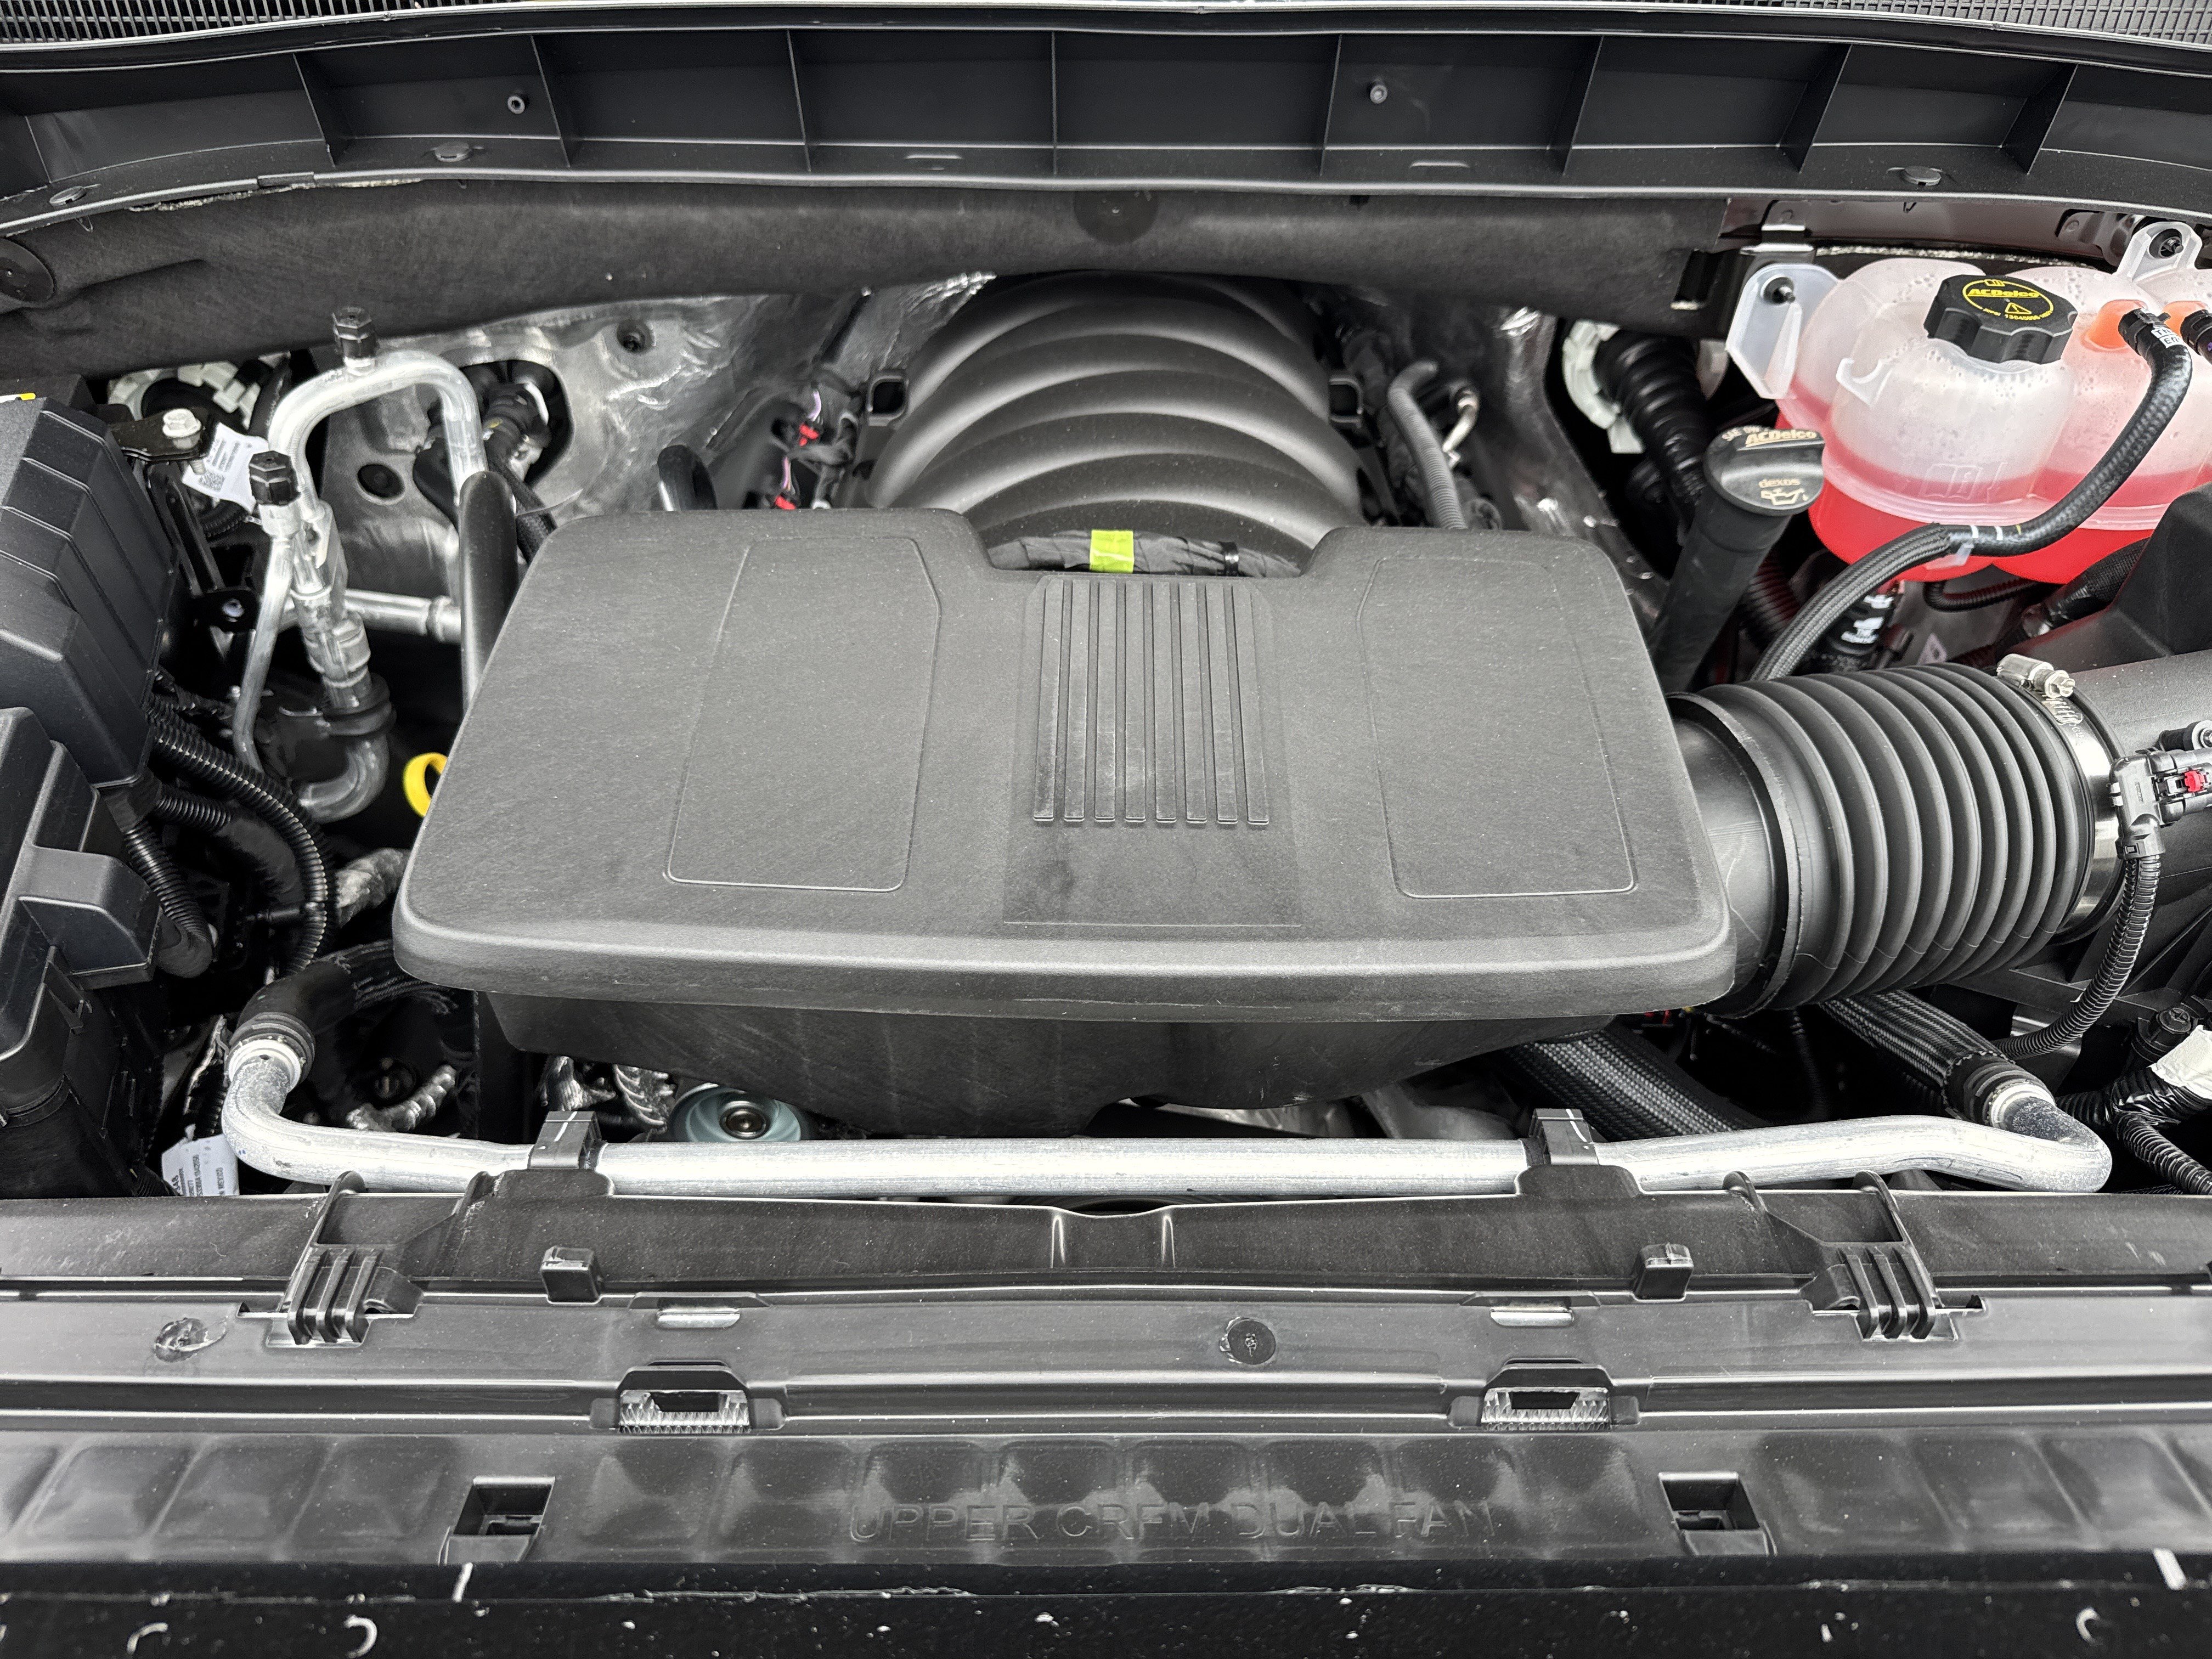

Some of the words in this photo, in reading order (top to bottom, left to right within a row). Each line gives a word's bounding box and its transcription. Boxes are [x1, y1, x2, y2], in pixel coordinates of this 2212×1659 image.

[1967, 288, 2040, 297] ACDelco
[1745, 430, 1817, 446] ACDelco
[1759, 478, 1801, 488] dexos
[849, 1502, 1039, 1542] UPPER
[1056, 1501, 1210, 1541] CRFM
[1231, 1500, 1377, 1539] DUAL
[1390, 1499, 1496, 1538] FAN
